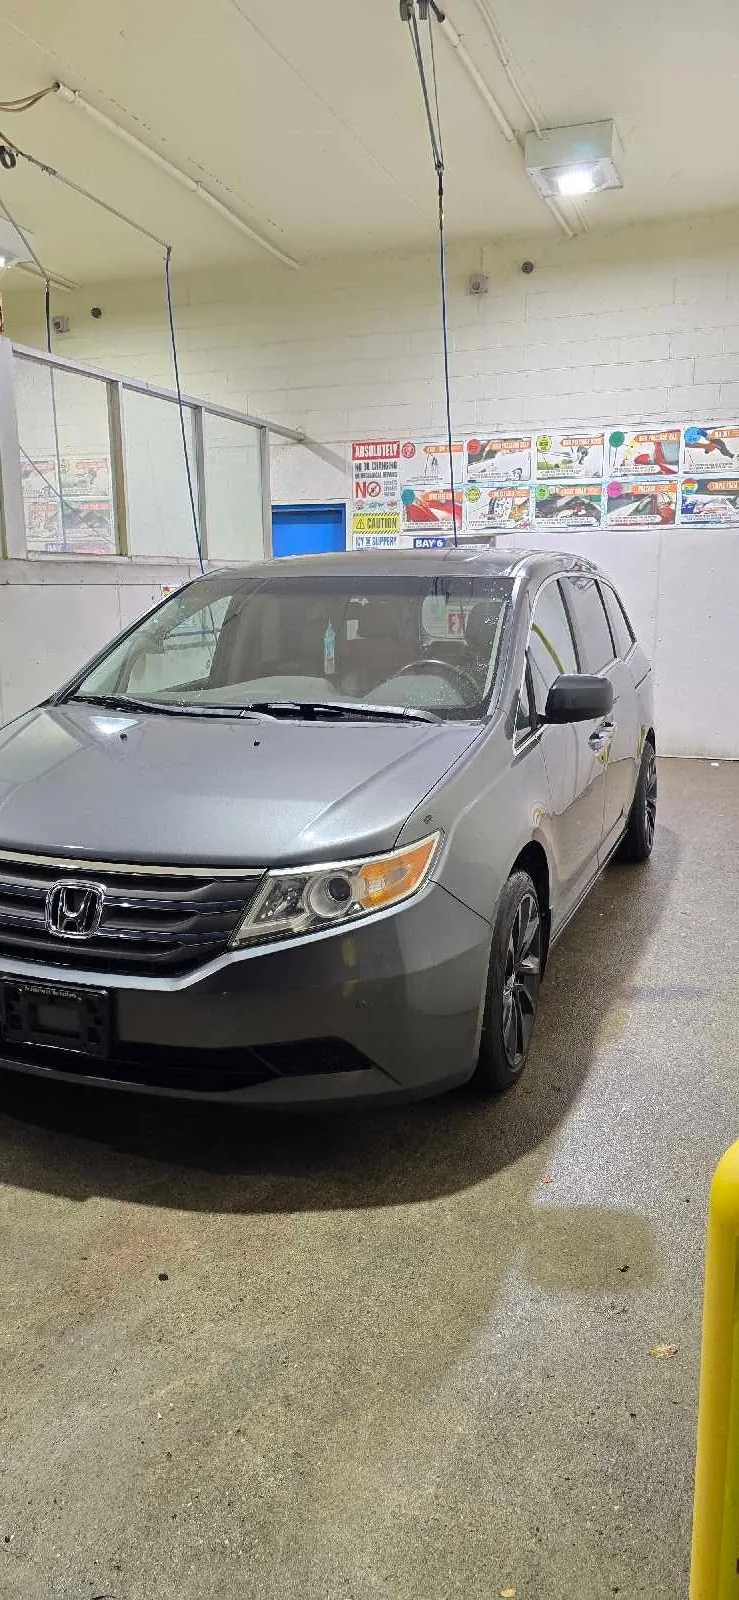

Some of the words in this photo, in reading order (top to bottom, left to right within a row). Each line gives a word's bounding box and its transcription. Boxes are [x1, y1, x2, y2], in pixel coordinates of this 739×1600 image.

[354, 443, 398, 458] ABSOLUTELY
[354, 463, 362, 471] NO
[371, 461, 398, 470] CHANGING
[366, 516, 397, 530] CAUTION
[355, 537, 364, 547] ICY
[415, 539, 434, 548] BAY
[436, 539, 444, 548] 6
